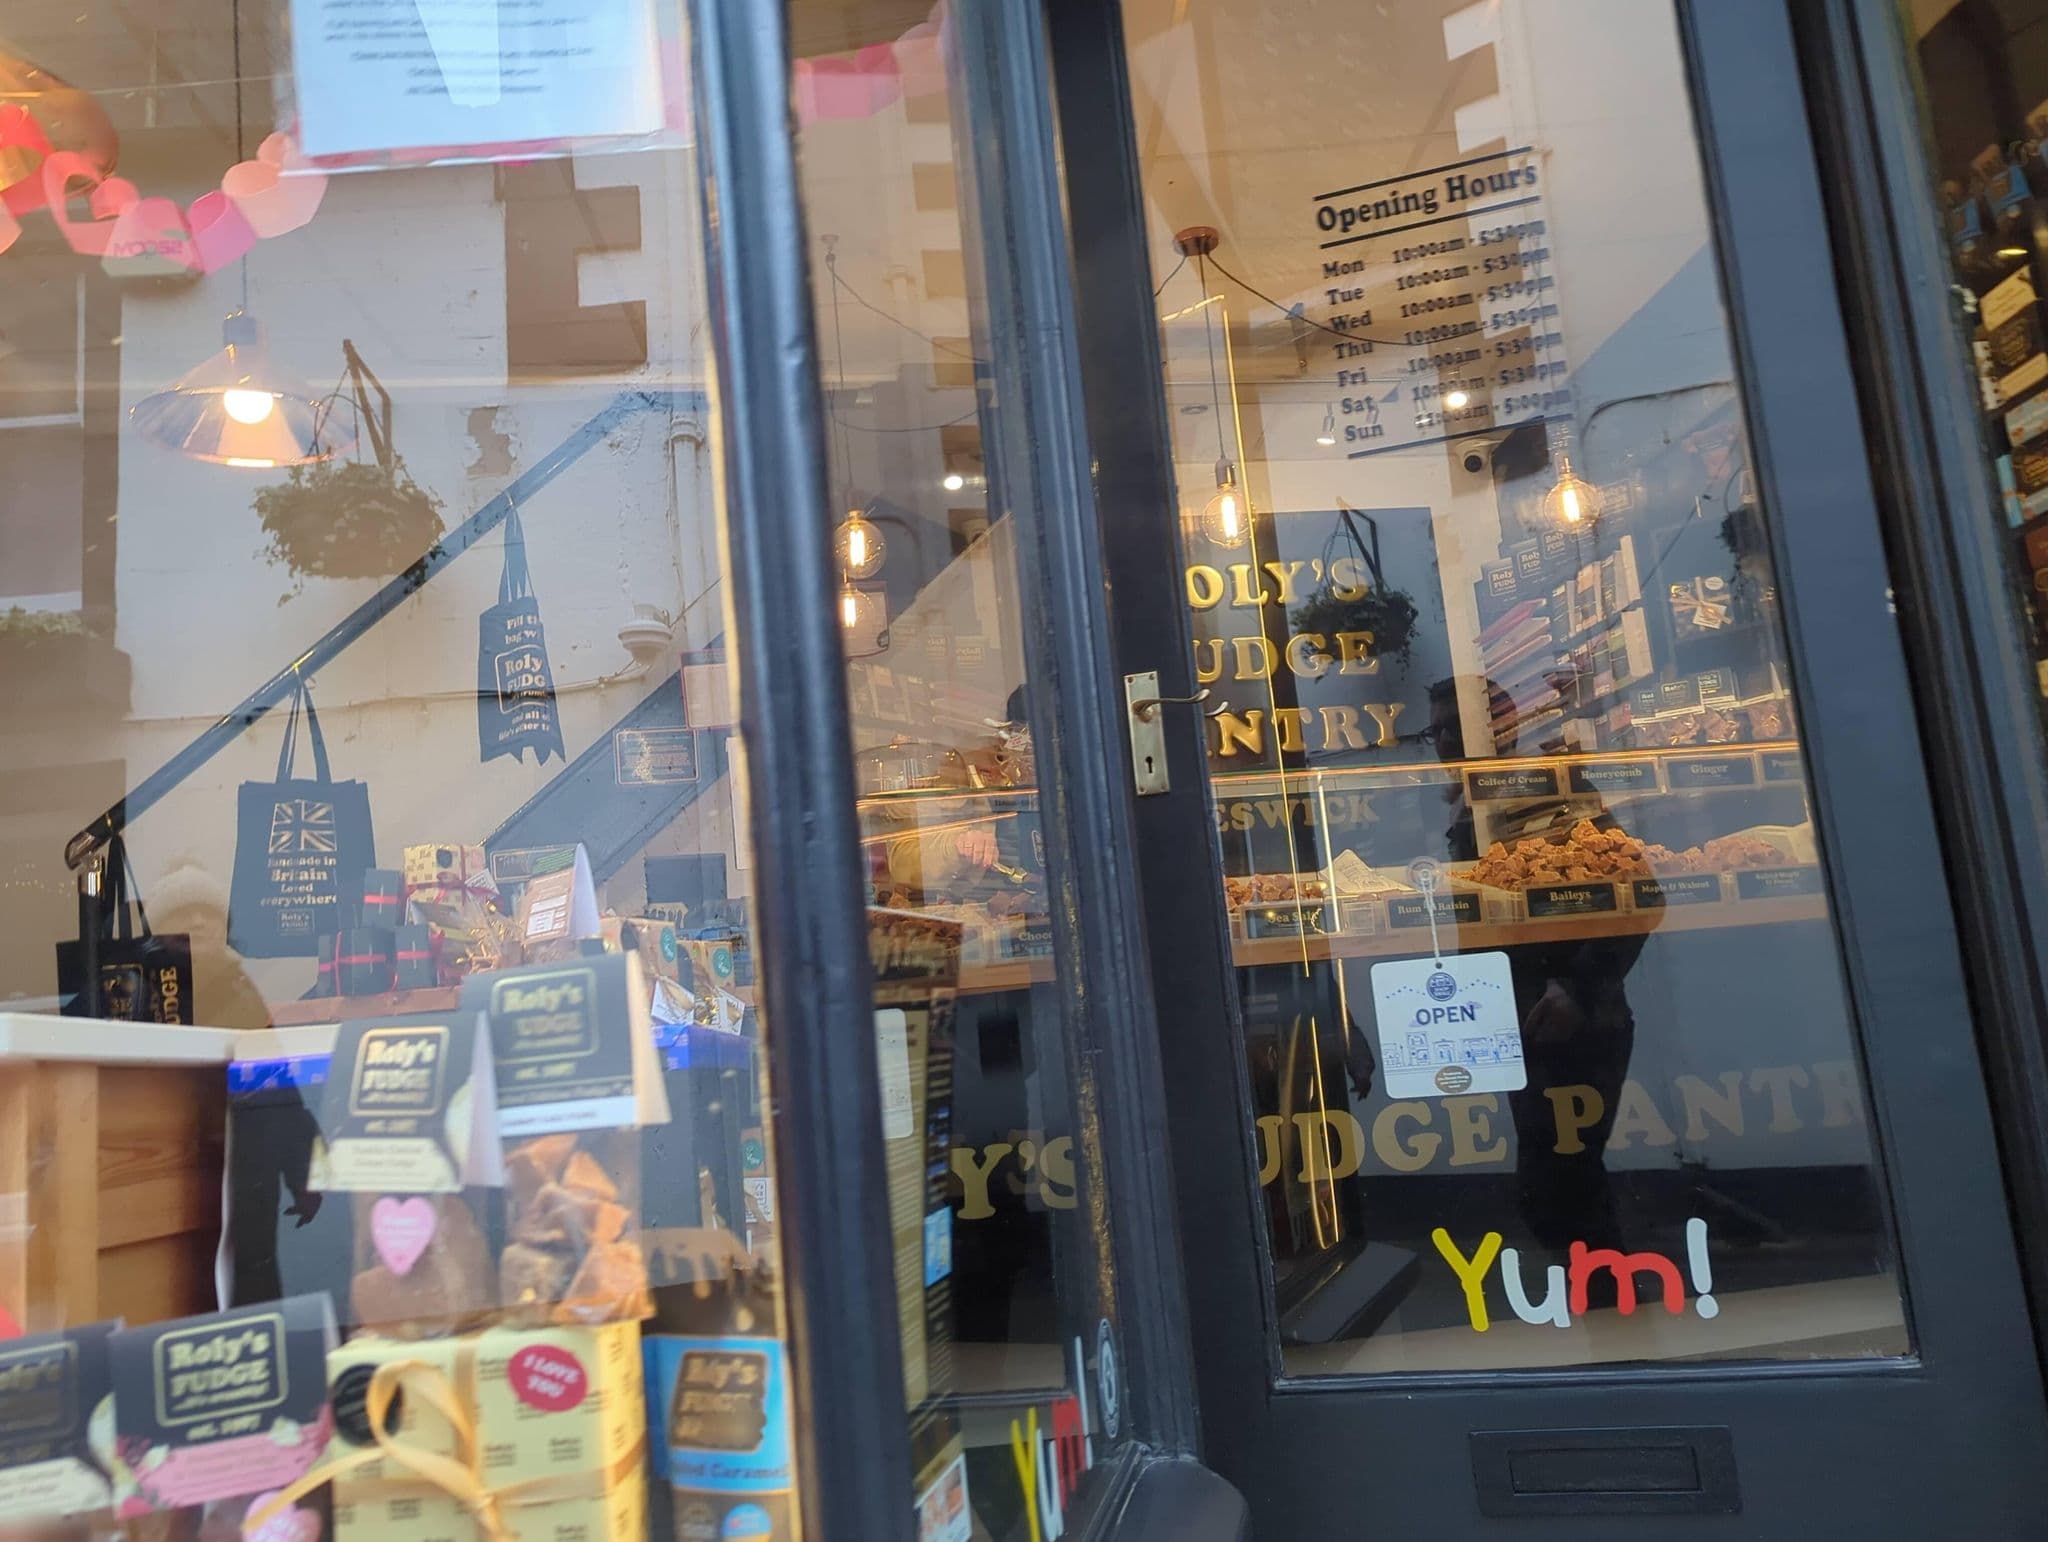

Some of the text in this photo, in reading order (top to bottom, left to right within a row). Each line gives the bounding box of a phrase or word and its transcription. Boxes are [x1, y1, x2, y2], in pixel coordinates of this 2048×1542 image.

[1317, 165, 1538, 231] Opening Hours
[1323, 258, 1365, 279] Mon
[1392, 238, 1465, 264] 10:00am
[1480, 220, 1546, 246] 5:30pm
[1327, 286, 1365, 305] Tue
[1397, 265, 1470, 290] 10:00am
[1484, 248, 1549, 274] 5:30pm
[1329, 311, 1372, 332] Wed
[1400, 293, 1474, 318] 10:00am
[1487, 276, 1554, 302] 5:30pm
[1333, 340, 1374, 360] Thu
[1491, 304, 1558, 330] 5:30pm
[1337, 366, 1367, 388] Fri
[1407, 349, 1482, 375] 10:00am
[1495, 332, 1562, 358] 5:30pm
[1341, 395, 1374, 415] Sat
[1500, 360, 1567, 386] 5:30pm
[1345, 423, 1384, 442] Sun
[1505, 388, 1572, 415] 5:00pm
[1194, 632, 1380, 683] UDGE
[1206, 703, 1406, 756] NTRY
[1477, 776, 1508, 787] Coffee
[1517, 775, 1548, 785] Cream
[1581, 767, 1643, 780] Honeycomb
[1690, 763, 1729, 775] Ginger
[1397, 904, 1422, 915] Rum
[1550, 888, 1592, 902] Baileys
[1416, 1004, 1477, 1026] OPEN
[1432, 1217, 1719, 1332] Yum!
